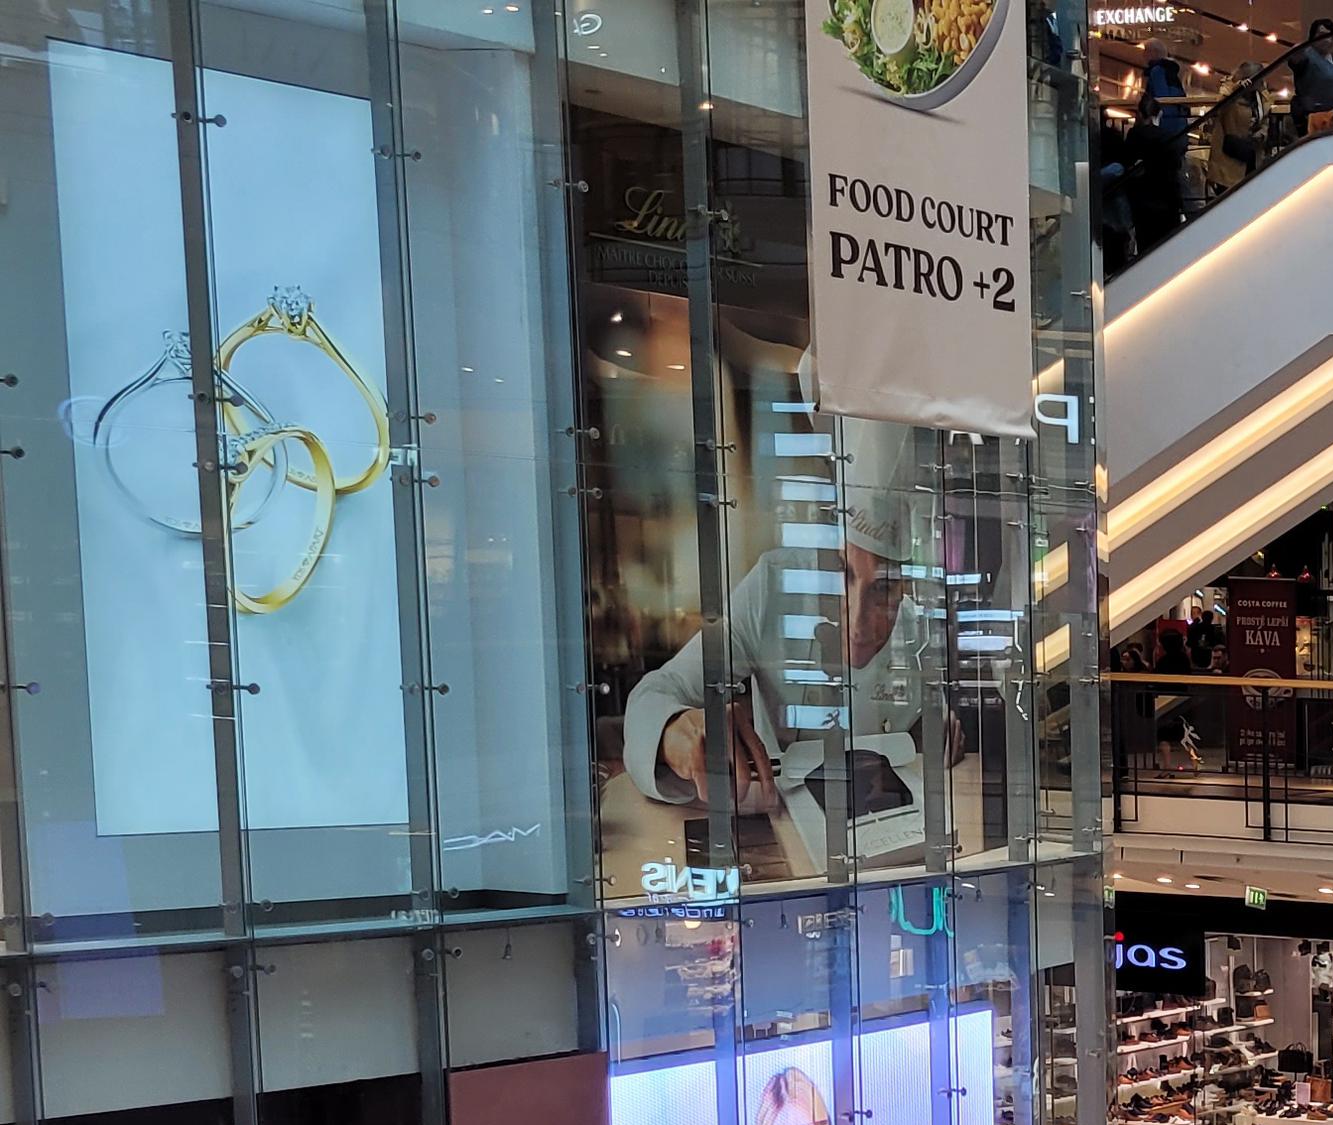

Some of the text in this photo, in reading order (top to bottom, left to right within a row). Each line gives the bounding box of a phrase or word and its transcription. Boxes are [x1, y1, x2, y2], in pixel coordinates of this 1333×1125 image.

[1096, 7, 1175, 25] EXCHANGE
[614, 187, 688, 241] Lin
[828, 173, 1014, 246] FOOD COURT
[829, 231, 1015, 312] PATRO +2
[1237, 600, 1287, 608] COSTA COFFEE
[1245, 627, 1281, 646] KÁVA
[1114, 931, 1187, 970] jas
